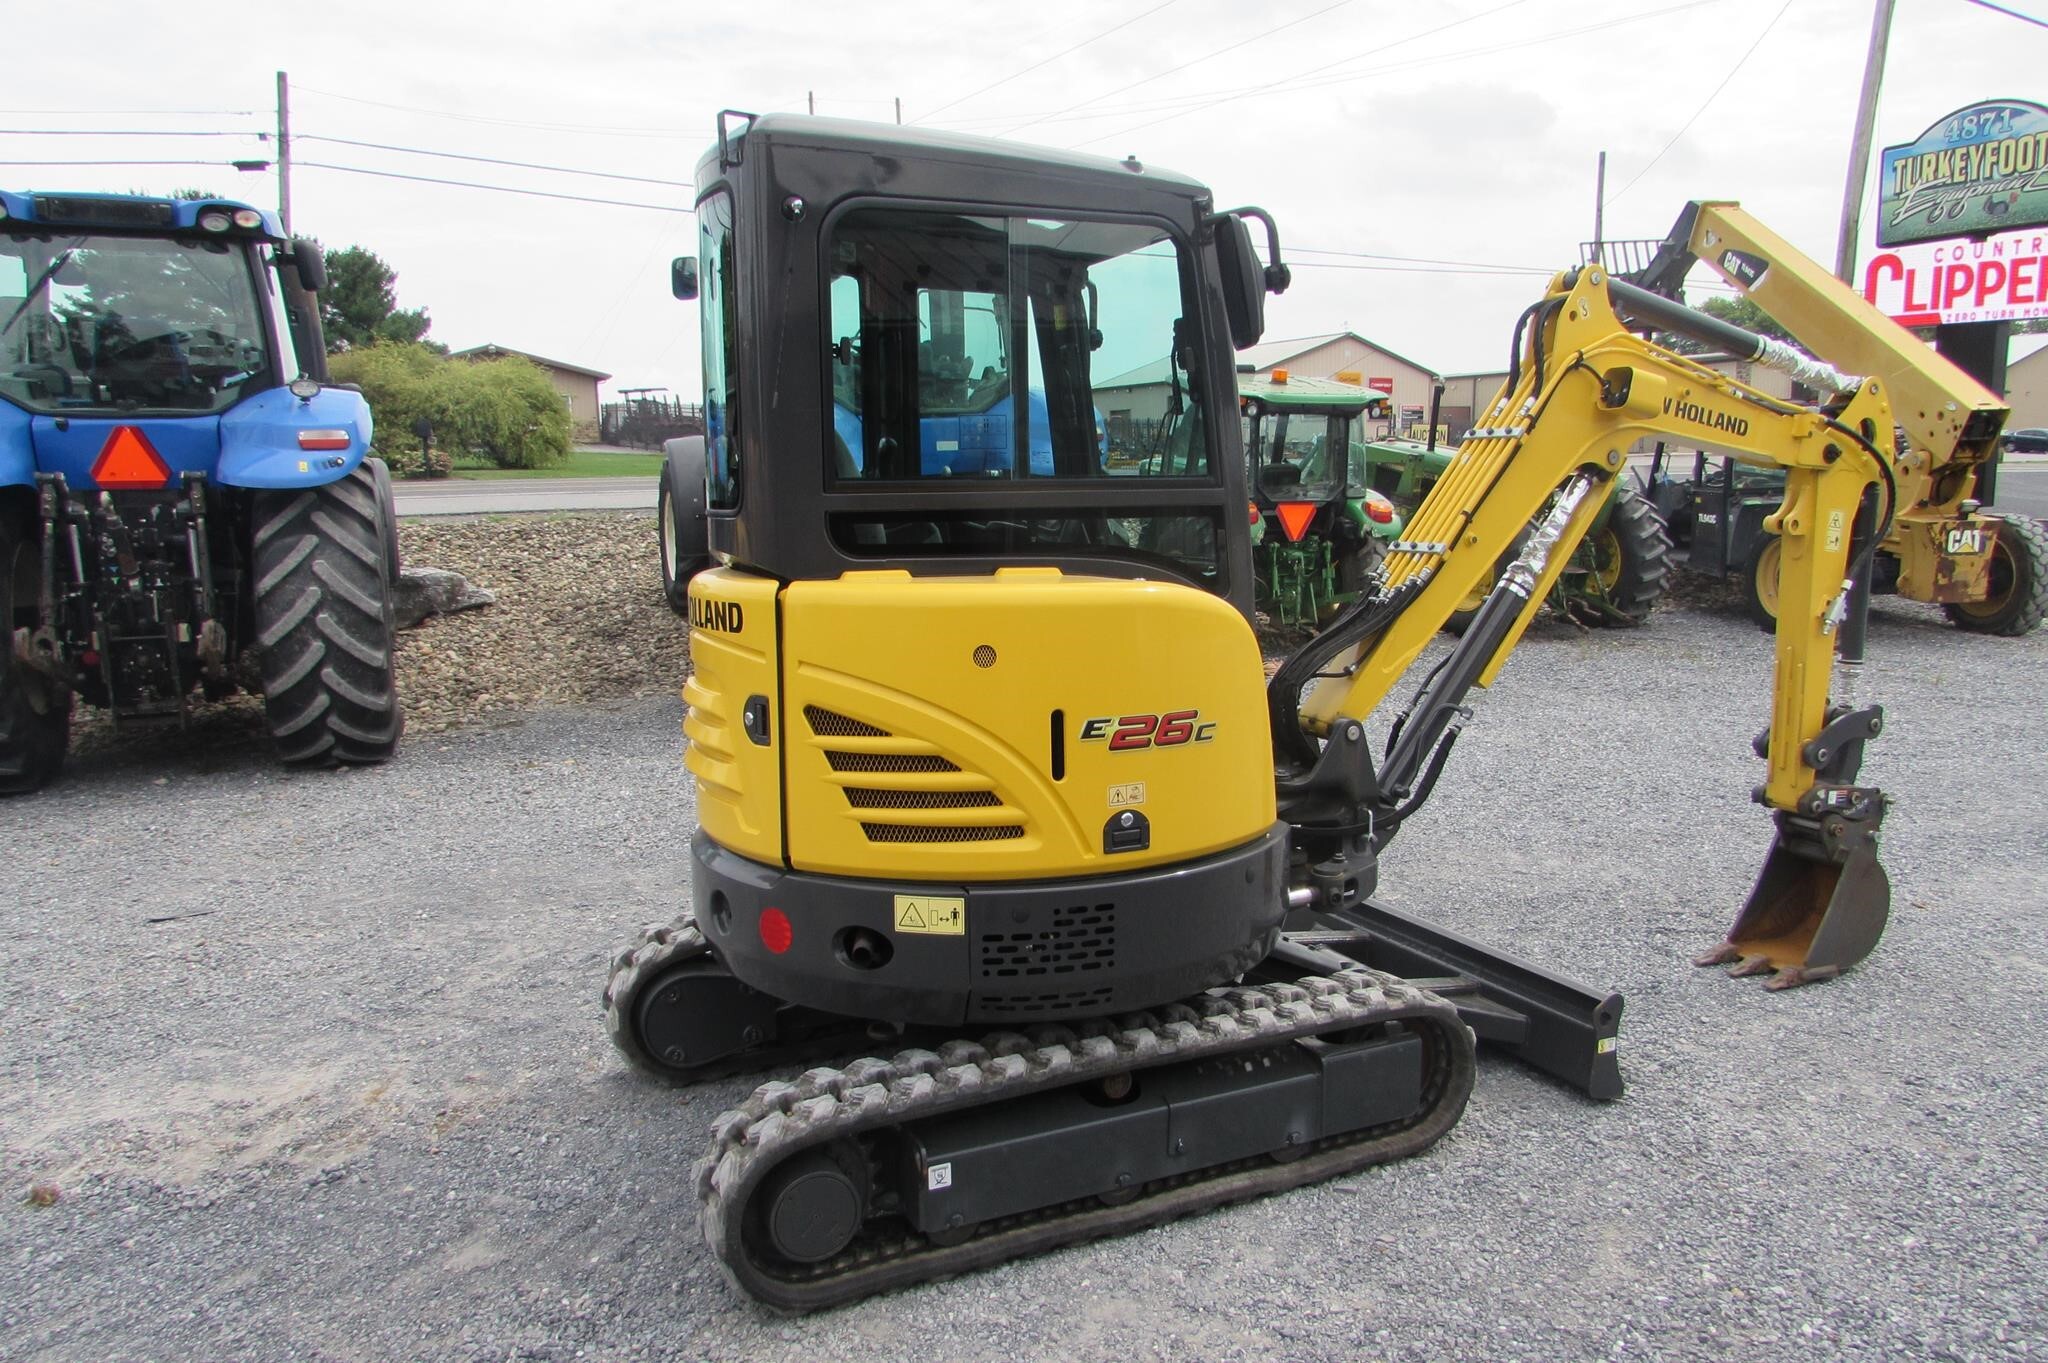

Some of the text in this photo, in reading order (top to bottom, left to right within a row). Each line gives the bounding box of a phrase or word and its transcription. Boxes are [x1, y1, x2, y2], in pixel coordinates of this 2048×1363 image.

[1944, 108, 2013, 143] 4871
[1893, 131, 2048, 196] TURKEYFOOT
[1933, 233, 2048, 263] COUNTR
[1723, 251, 1741, 276] CAT
[1946, 312, 1977, 322] ZERO
[1985, 309, 2015, 319] TURN
[1674, 400, 1749, 437] HOLLAND
[1947, 529, 1981, 553] CAT
